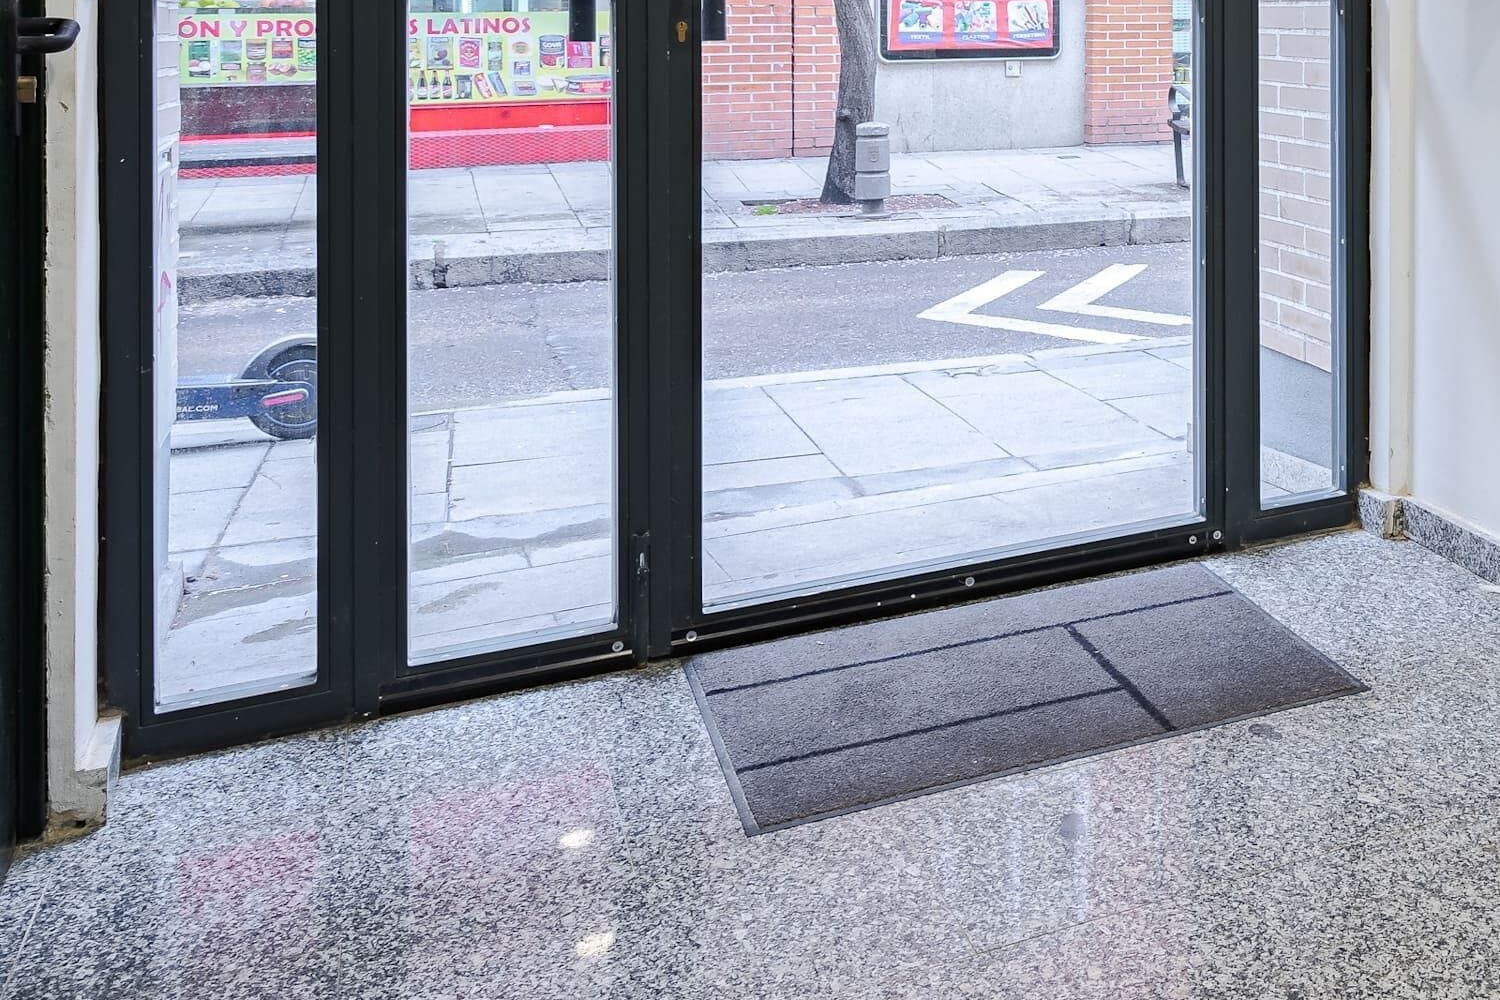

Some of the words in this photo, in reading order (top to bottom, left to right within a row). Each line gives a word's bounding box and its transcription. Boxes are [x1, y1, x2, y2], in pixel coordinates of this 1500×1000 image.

[178, 16, 220, 39] ÓN
[230, 19, 248, 38] Y
[256, 19, 315, 38] PRO
[426, 16, 532, 35] LATINOS
